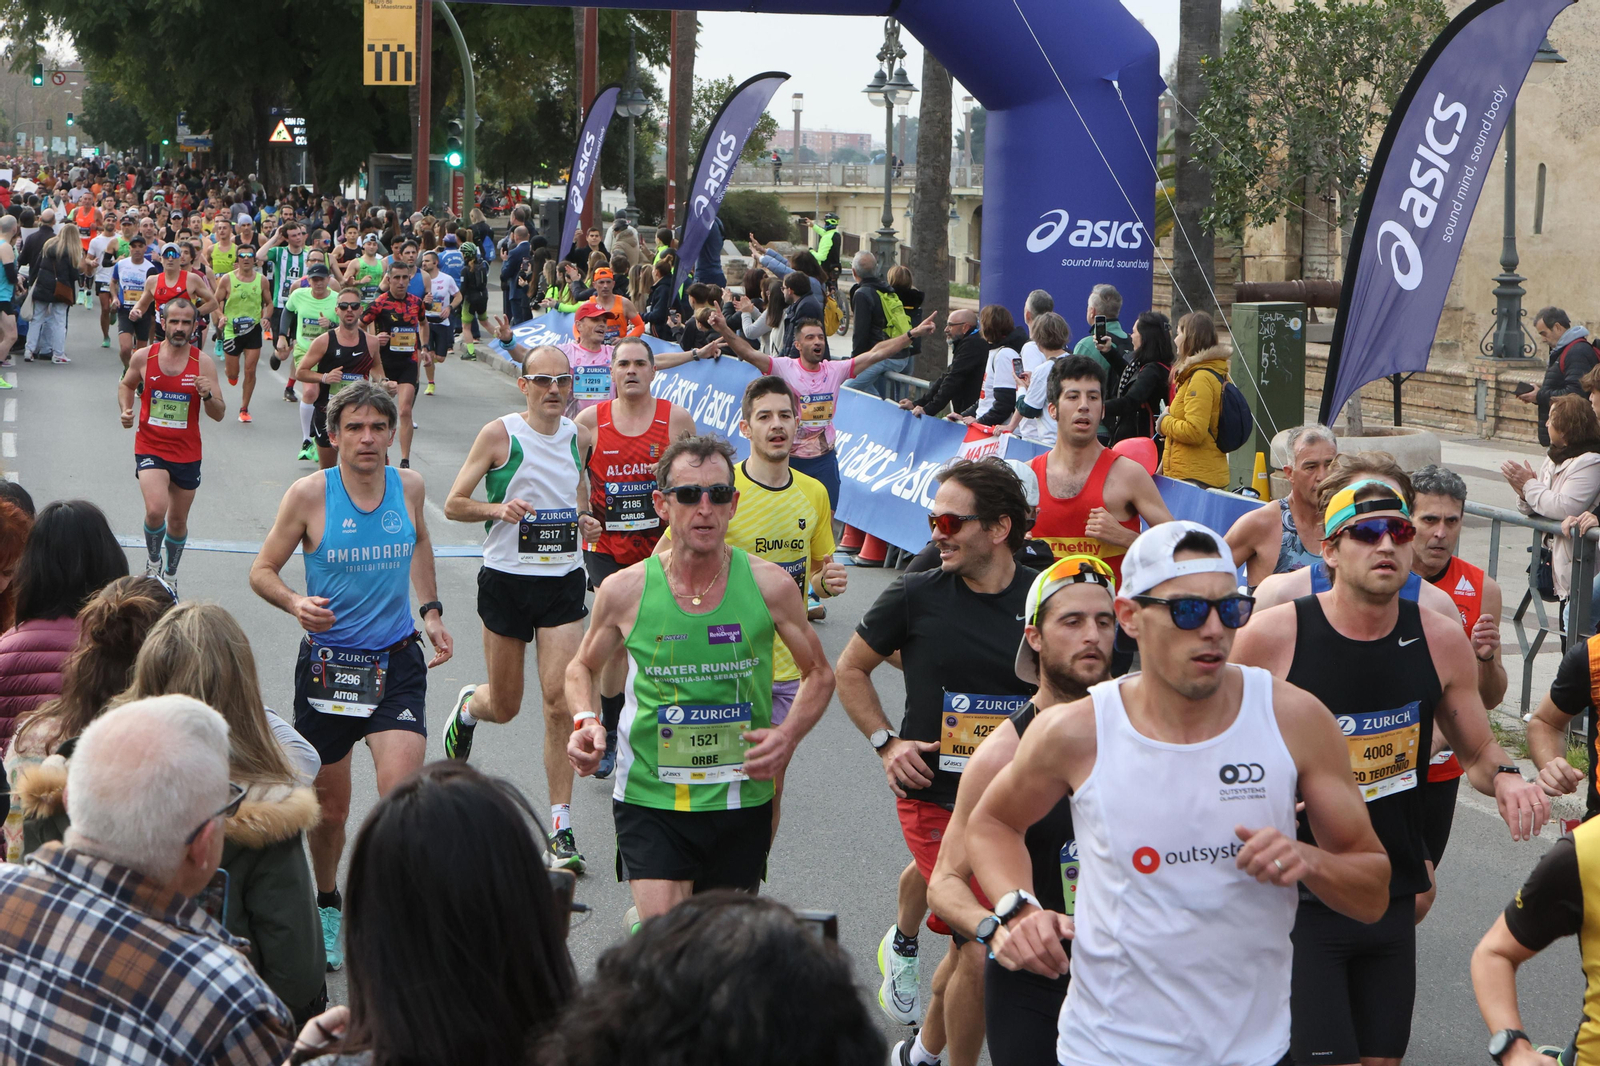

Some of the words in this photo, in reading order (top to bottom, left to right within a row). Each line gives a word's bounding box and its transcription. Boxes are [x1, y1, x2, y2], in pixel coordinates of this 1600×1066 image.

[1443, 200, 1464, 243] sound
[1456, 166, 1478, 202] mind,
[1470, 119, 1492, 162] sound
[1484, 84, 1508, 120] body
[1062, 258, 1092, 267] sound
[1092, 258, 1115, 269] mind,
[1117, 259, 1138, 268] sound
[1138, 260, 1150, 270] body
[623, 500, 641, 508] 2185
[541, 512, 572, 520] ZURICH
[540, 530, 560, 539] 2517
[791, 540, 804, 549] GO
[782, 562, 802, 573] URICH
[645, 664, 698, 676] KRATER
[701, 657, 760, 674] RUNNERS
[335, 673, 360, 685] 2296
[654, 675, 712, 684] DONOSTIA-SAN
[333, 690, 358, 701] AITOR
[976, 700, 1023, 710] ZURICH
[691, 708, 740, 720] ZURICH
[1363, 711, 1410, 730] ZURICH
[690, 734, 718, 746] 1521
[952, 744, 975, 755] KILO
[1364, 743, 1393, 760] 4008
[692, 755, 718, 765] ORBE
[1369, 760, 1409, 780] TEOTONIO
[1219, 787, 1266, 795] OUTSYSTEMS
